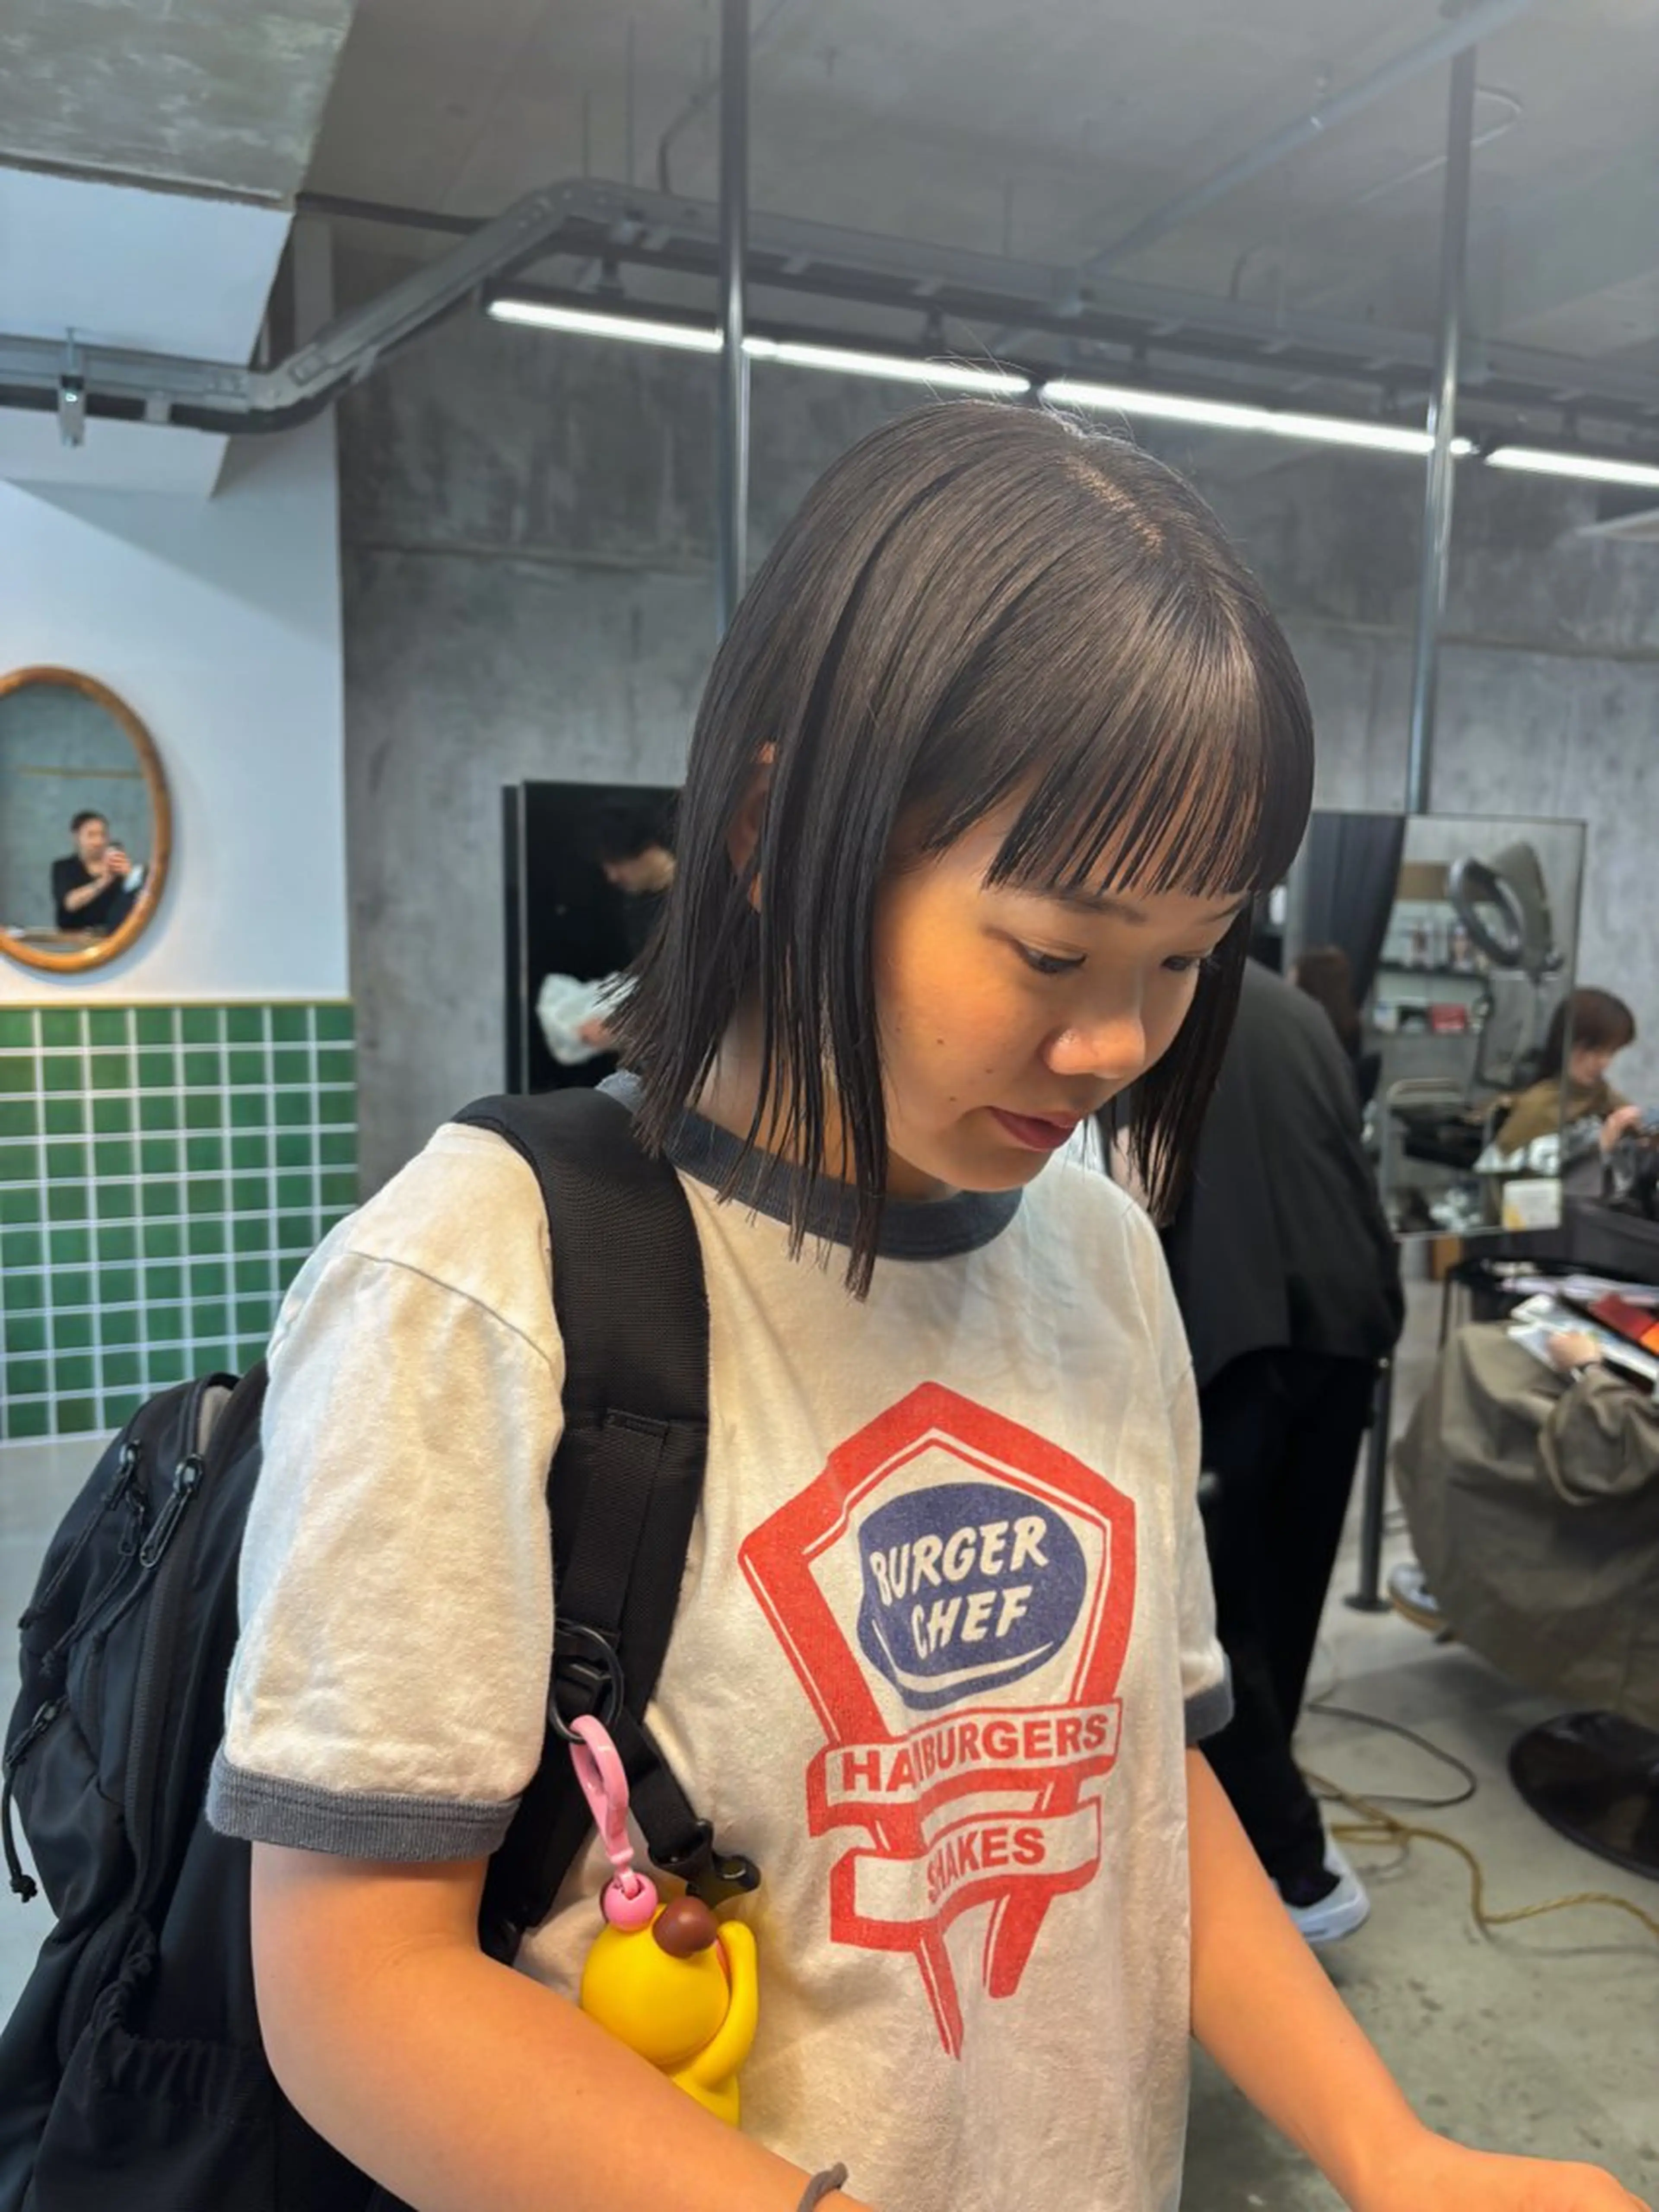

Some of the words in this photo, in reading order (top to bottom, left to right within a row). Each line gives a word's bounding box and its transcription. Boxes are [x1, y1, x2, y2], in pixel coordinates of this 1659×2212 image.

[870, 1516, 1049, 1606] BURGER
[912, 1585, 1033, 1659] CHEF
[927, 1827, 1046, 1904] SHAKES
